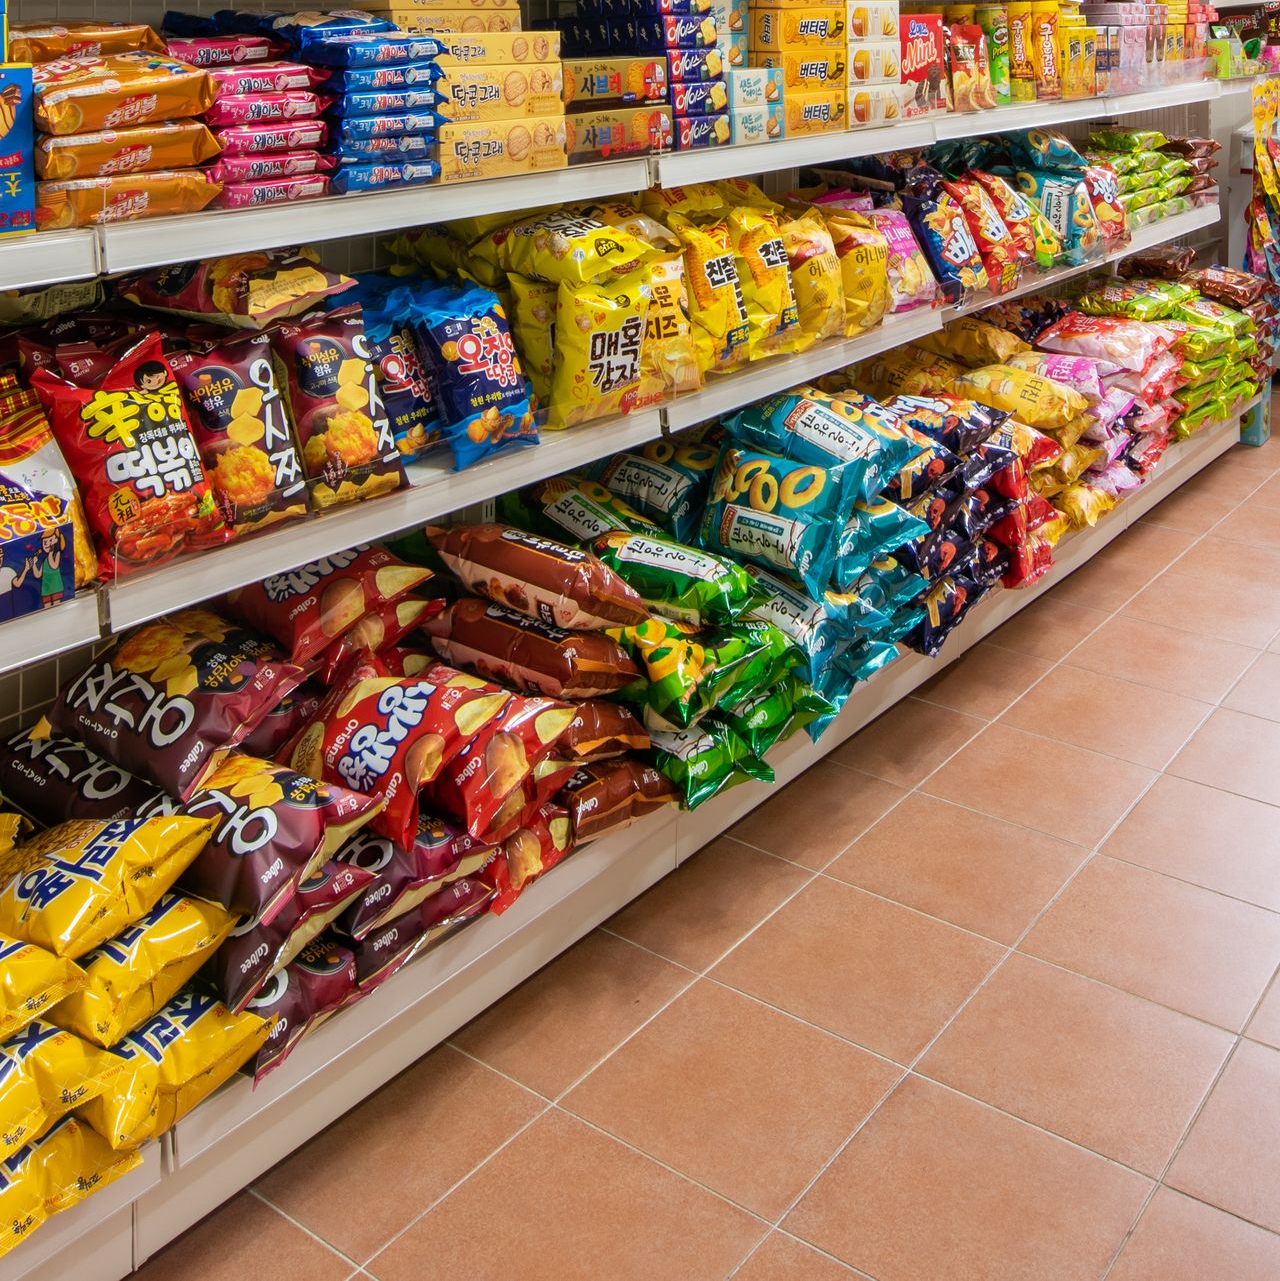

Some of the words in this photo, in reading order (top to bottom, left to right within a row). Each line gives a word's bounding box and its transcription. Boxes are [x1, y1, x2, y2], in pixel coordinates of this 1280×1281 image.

[799, 19, 829, 39] 버터링
[902, 33, 937, 74] Mini
[1039, 22, 1057, 78] 구운감자
[800, 61, 828, 80] 버터링
[803, 103, 831, 122] 버터링
[472, 318, 499, 337] 구운
[589, 315, 641, 362] 매혹
[189, 377, 235, 404] 식이섬유
[485, 367, 517, 388] 땅콩
[587, 357, 641, 395] 감자
[203, 397, 225, 412] 함유
[249, 357, 308, 498] 오사쯔
[105, 430, 202, 497] 떡볶이
[111, 493, 136, 524] 元祖
[327, 718, 360, 769] Original
[337, 681, 437, 792] 생생칩
[178, 740, 205, 774] Calbee
[261, 856, 284, 884] Calbee
